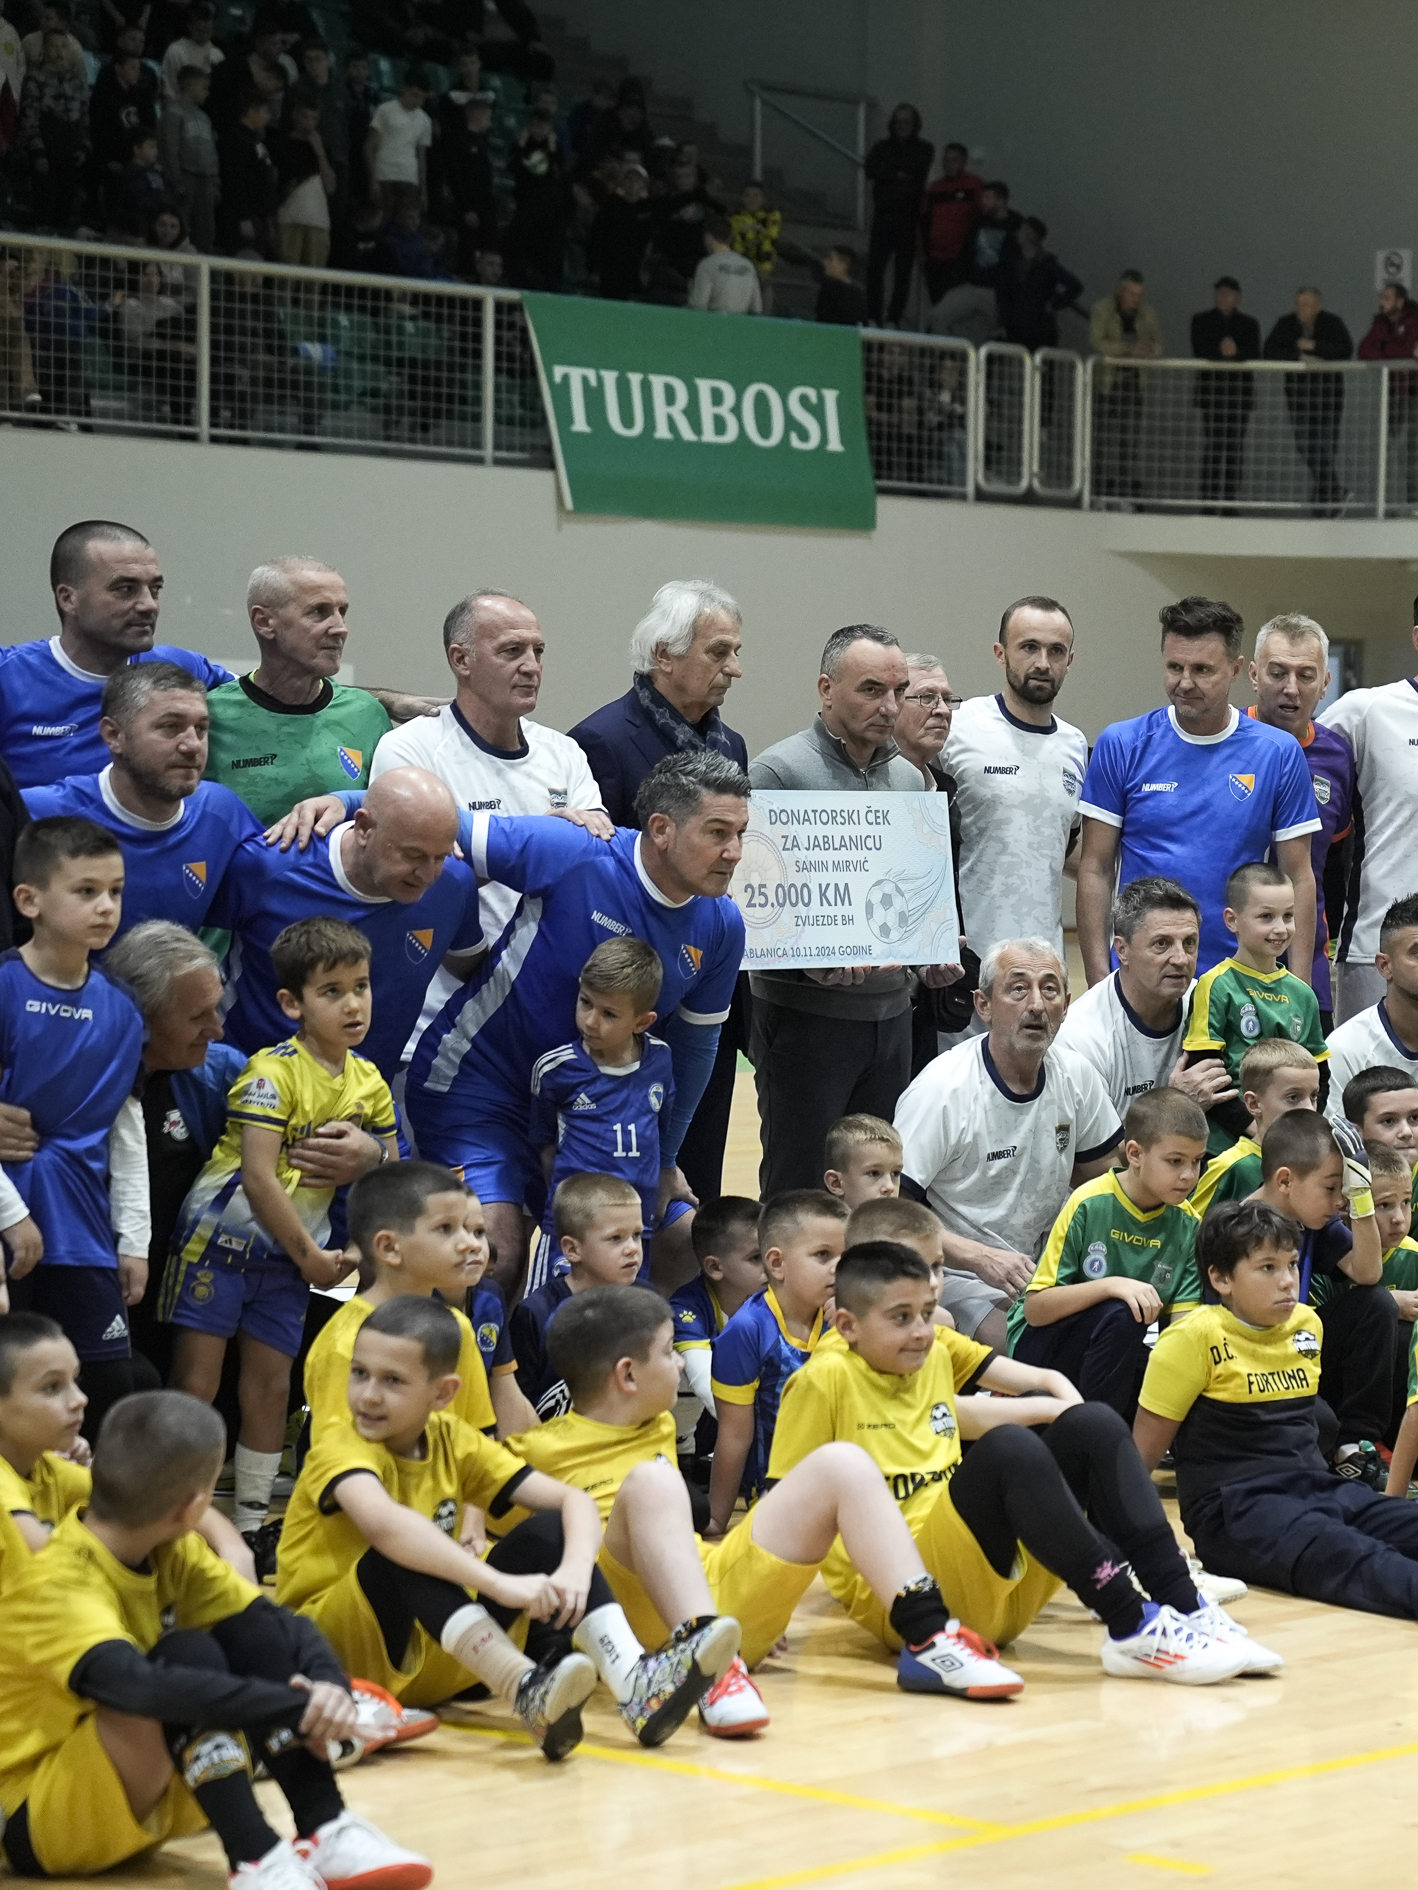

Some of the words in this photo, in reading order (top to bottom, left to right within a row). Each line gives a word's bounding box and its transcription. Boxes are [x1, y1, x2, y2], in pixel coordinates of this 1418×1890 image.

[553, 365, 845, 451] TURBOSI
[769, 808, 861, 826] DONATORSKI
[865, 805, 891, 826] ČEK
[781, 834, 801, 852] ZA
[804, 834, 882, 852] JABLANICU
[795, 860, 830, 873] SANIN
[832, 857, 869, 873] MIRVIĆ
[744, 883, 811, 908] 25.000
[819, 882, 852, 907] KM
[794, 915, 839, 927] ZVIJEZDE
[842, 914, 854, 926] BH
[743, 946, 788, 959] ABLANICA
[791, 946, 836, 957] 10.11.2024
[838, 945, 873, 956] GODINE
[1246, 988, 1289, 1003] GIVOVA
[25, 999, 93, 1021] GIVOVA
[572, 1103, 597, 1111] adidas
[613, 1123, 640, 1157] 11
[1110, 1229, 1161, 1249] GIVOVA
[1247, 1368, 1310, 1394] FORTUNA
